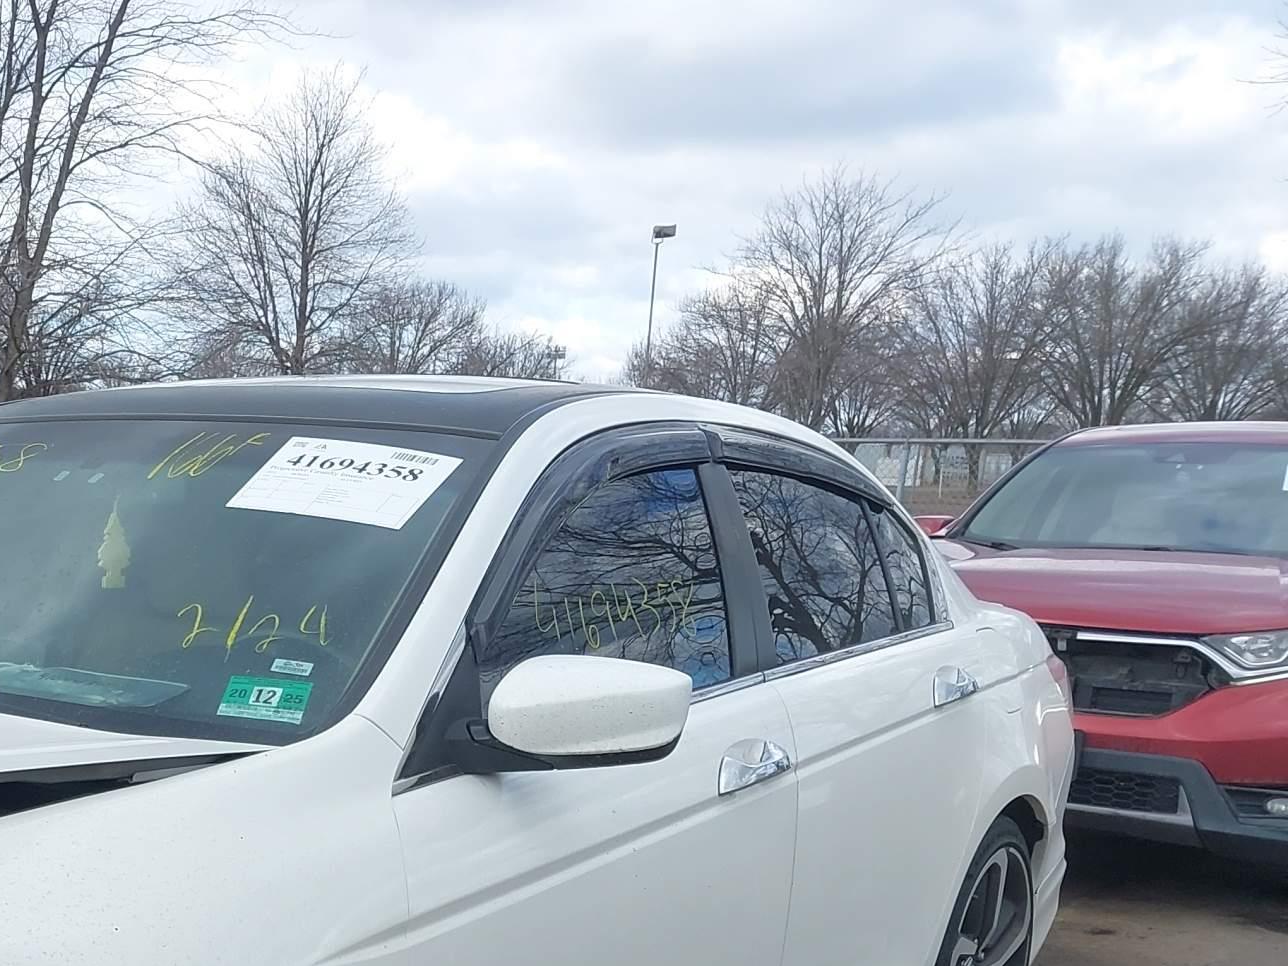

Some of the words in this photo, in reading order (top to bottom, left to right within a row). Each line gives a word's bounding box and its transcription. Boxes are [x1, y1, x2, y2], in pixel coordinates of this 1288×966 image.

[286, 453, 425, 482] 41694358
[229, 688, 248, 699] 20
[252, 688, 277, 705] 12
[283, 693, 304, 705] 25
